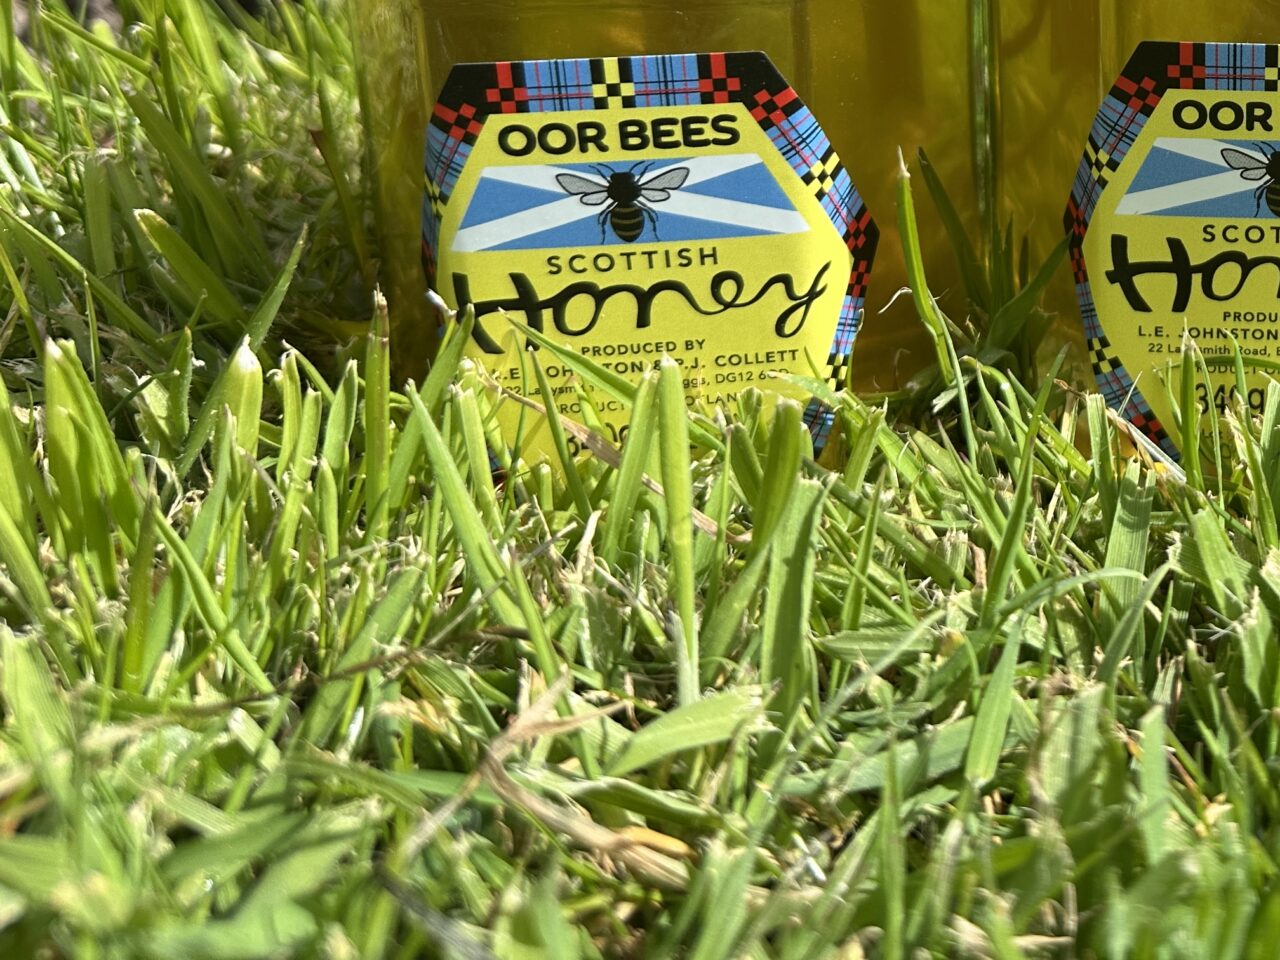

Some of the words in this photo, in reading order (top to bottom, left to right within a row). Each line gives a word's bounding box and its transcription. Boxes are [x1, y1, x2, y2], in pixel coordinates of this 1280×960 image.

[1172, 99, 1273, 132] OOR
[498, 121, 609, 157] OOR
[618, 114, 740, 152] BEES
[546, 245, 719, 276] SCOTTISH
[452, 260, 832, 354] Honey
[1138, 325, 1170, 338] L.E.
[581, 340, 678, 356] PRODUCED
[685, 338, 706, 351] BY
[1148, 342, 1164, 353] 22
[1167, 343, 1231, 355] Lasmith
[714, 348, 799, 367] COLLETT
[715, 370, 754, 384] DG12
